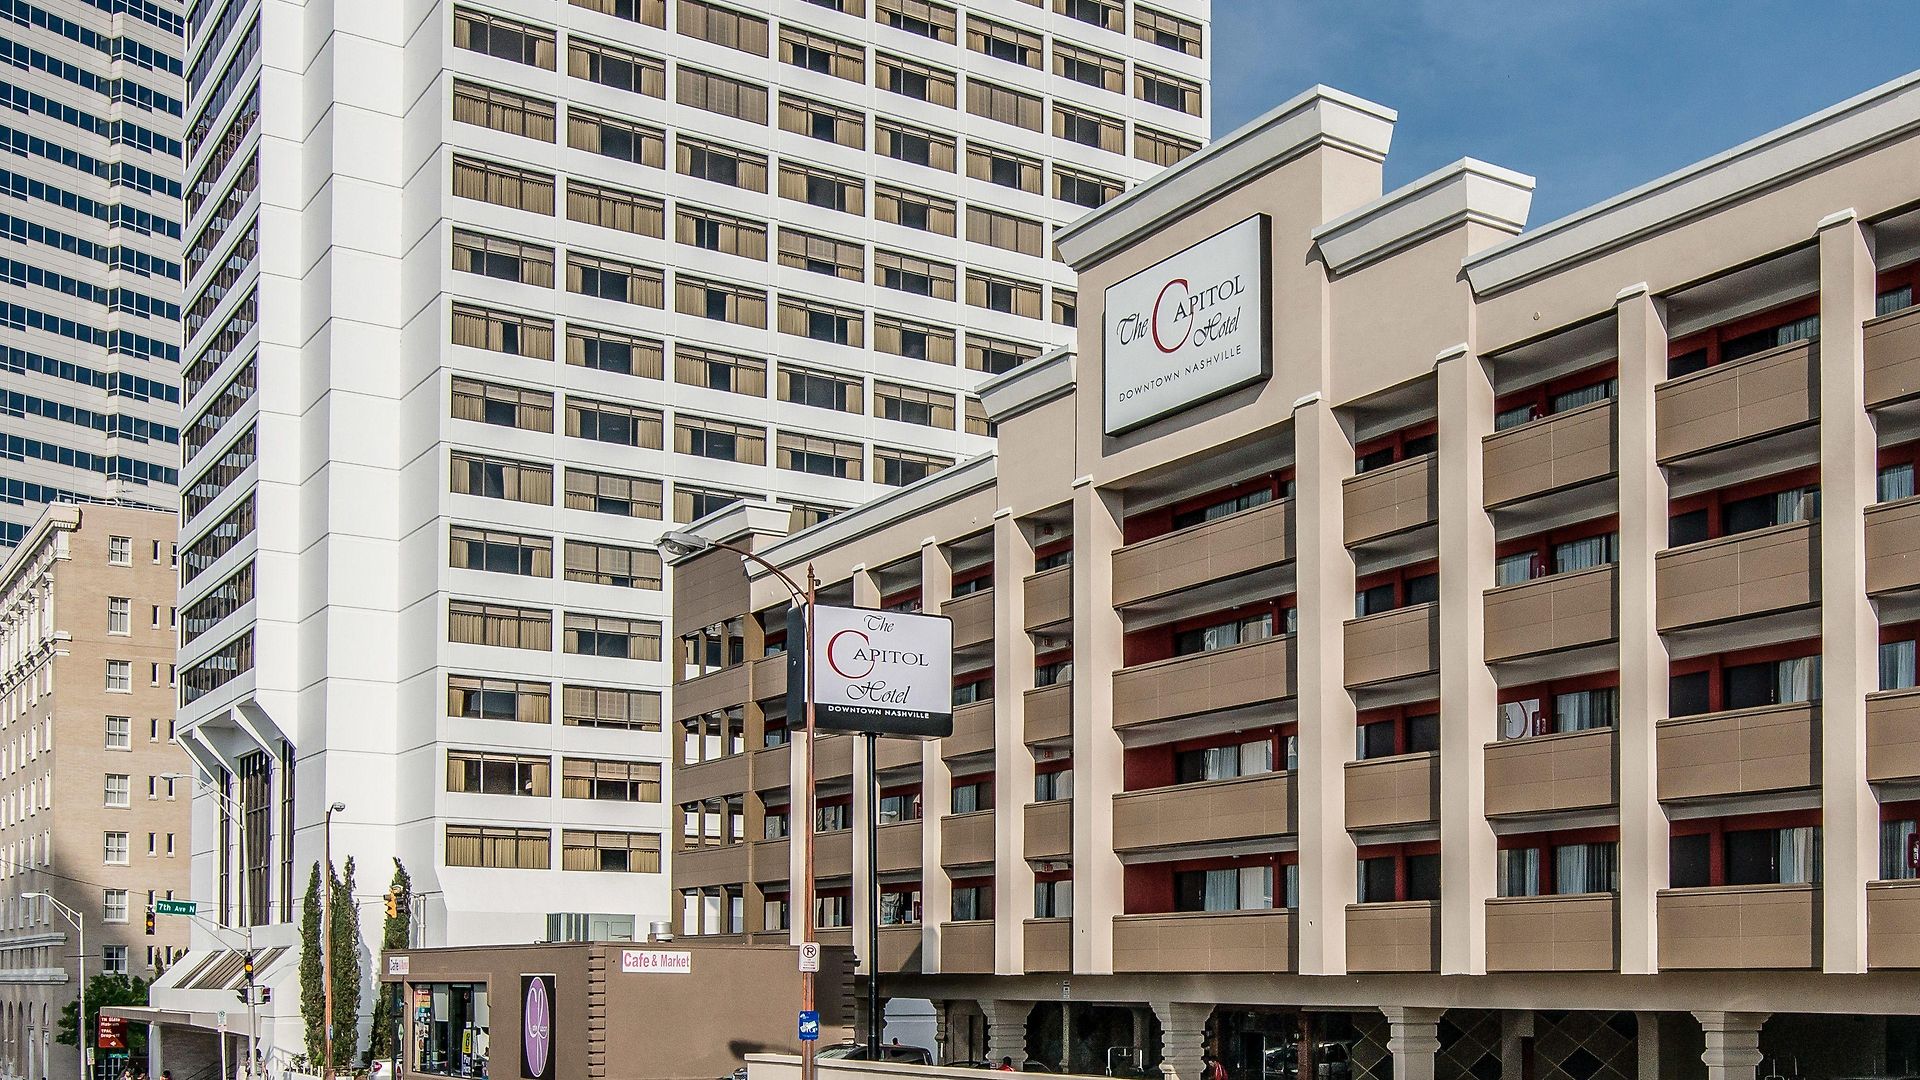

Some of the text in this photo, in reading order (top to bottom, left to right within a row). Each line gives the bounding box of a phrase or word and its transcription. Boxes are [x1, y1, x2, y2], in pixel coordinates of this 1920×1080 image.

[1116, 274, 1246, 354] The CAPITOL
[1193, 306, 1241, 347] Hotel
[1119, 345, 1242, 402] DOWNTOWN NASHVILLE
[863, 614, 895, 633] The
[827, 629, 929, 679] CAPITOL
[846, 680, 911, 704] Hotel
[828, 705, 930, 719] DOWNTOWN NASHVILLE
[158, 903, 171, 911] 7th
[189, 905, 195, 913] N
[624, 952, 690, 968] Cafe & Market
